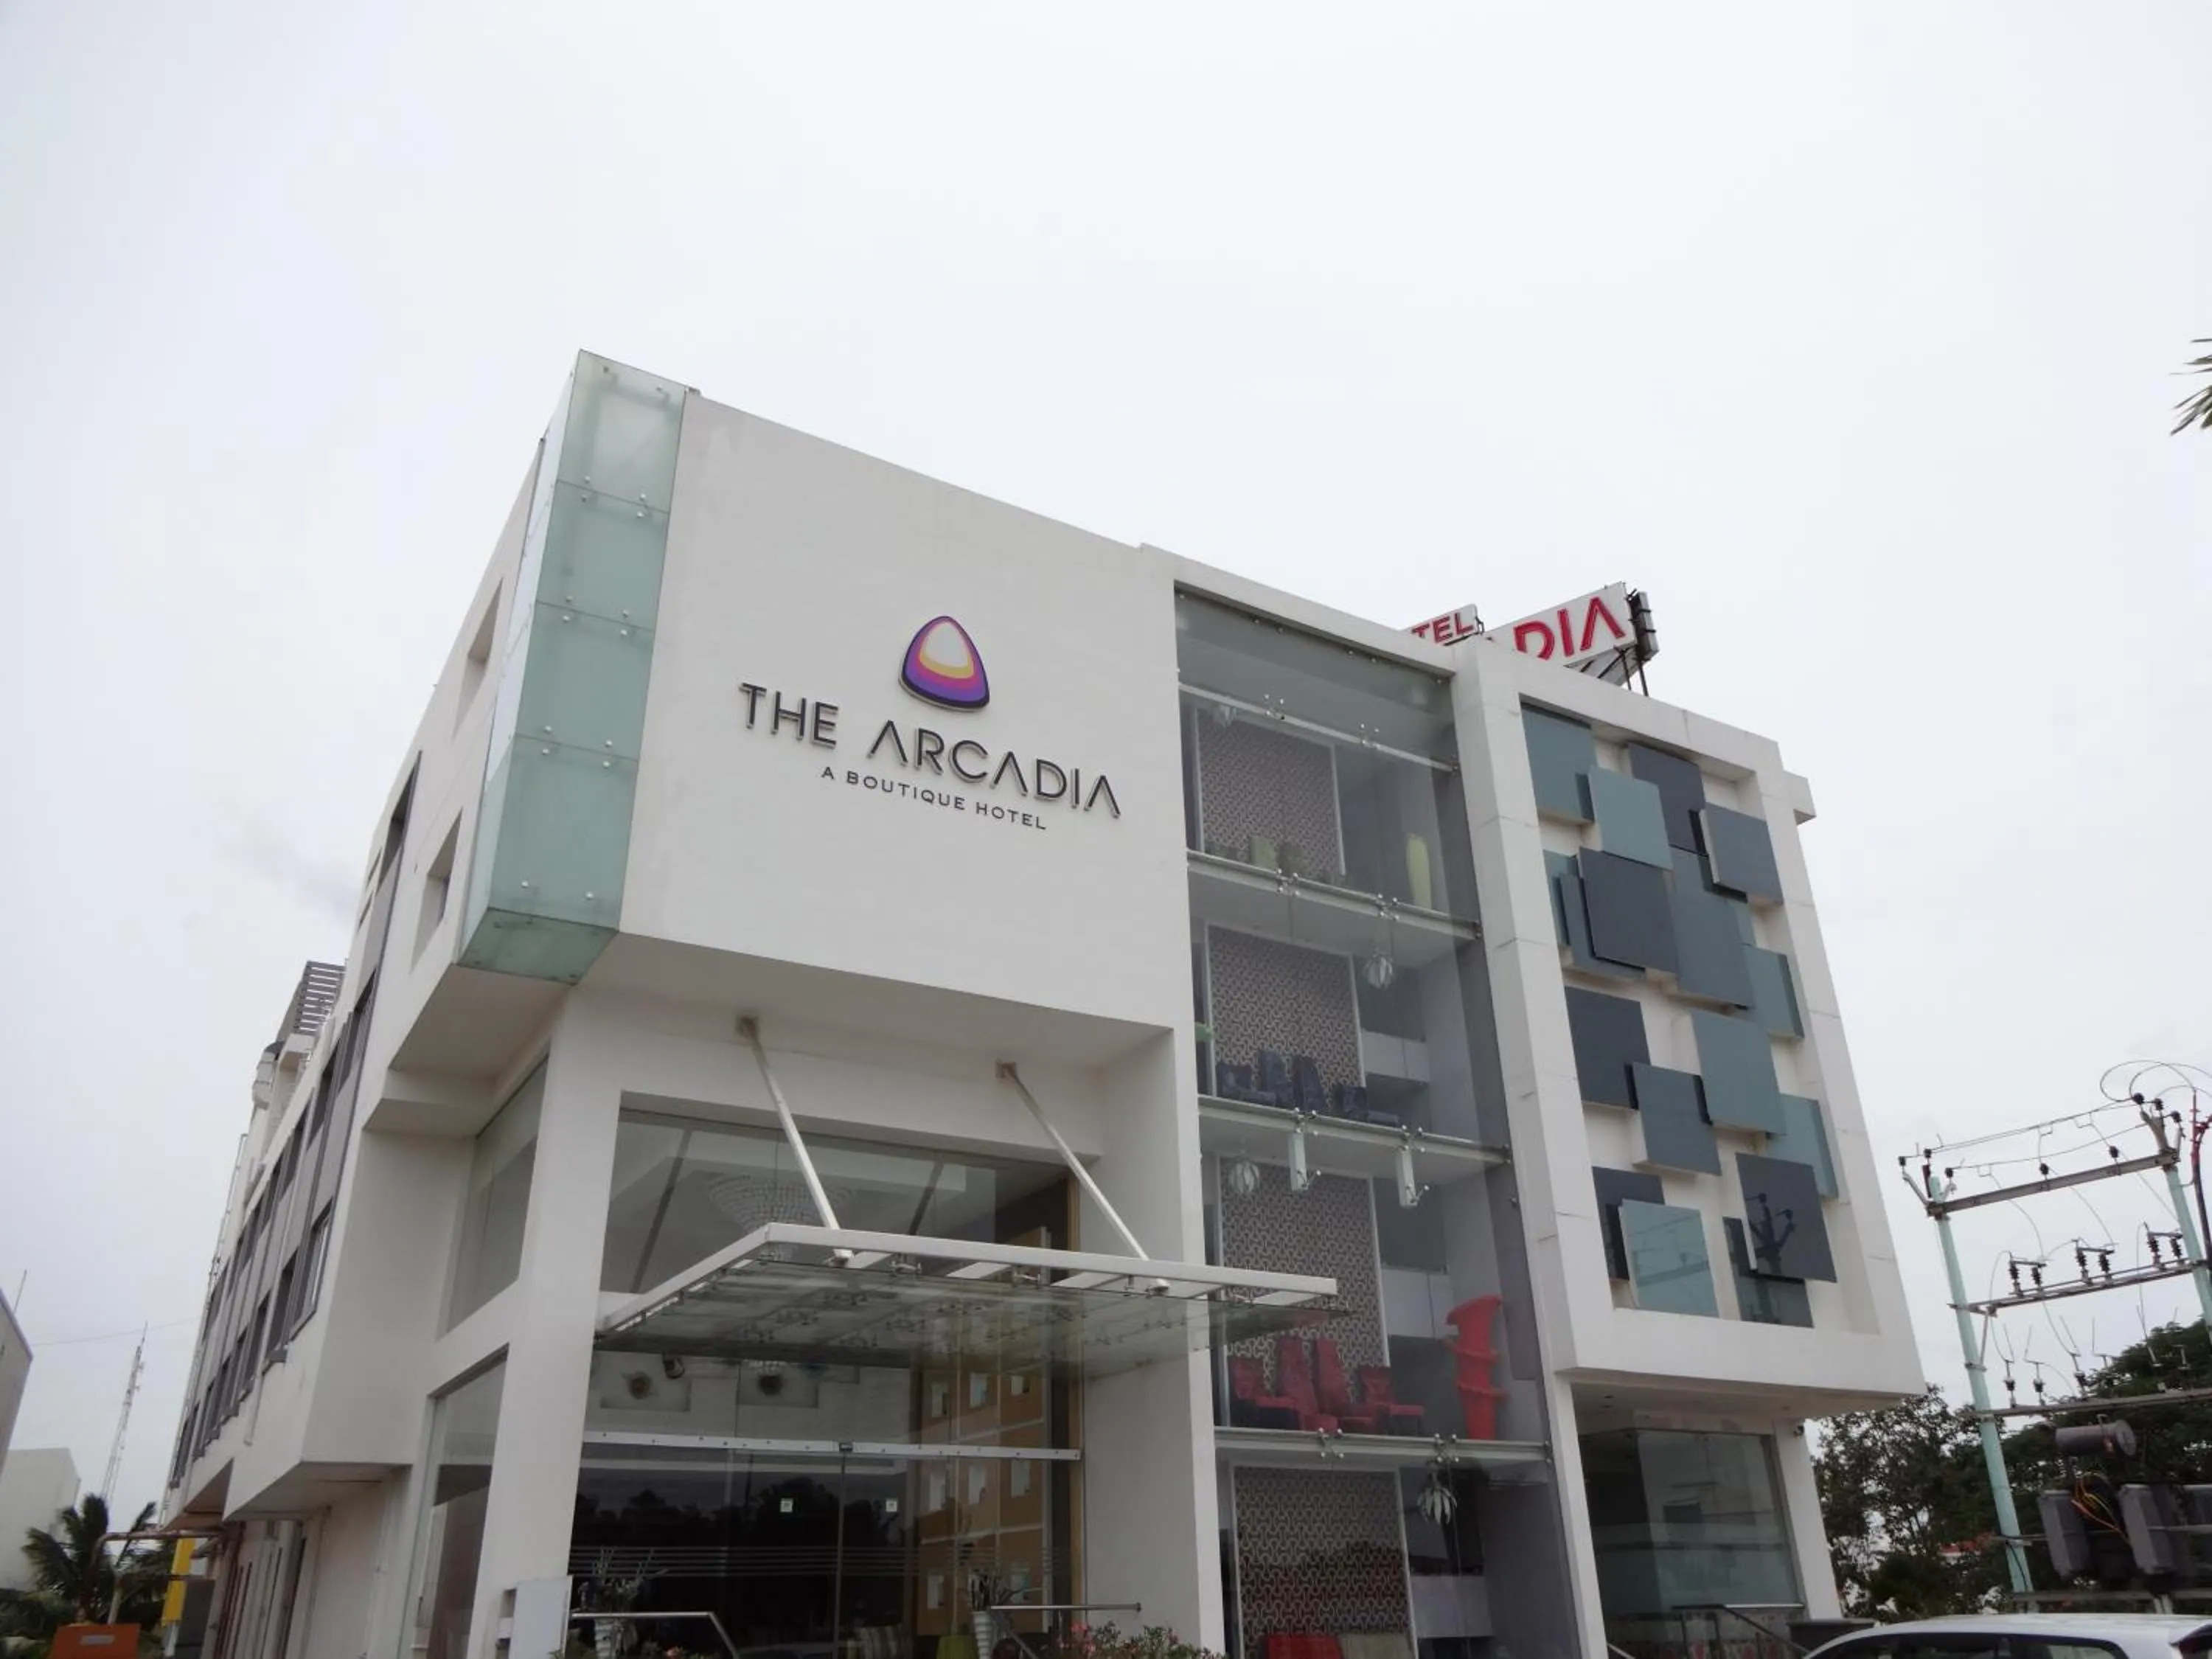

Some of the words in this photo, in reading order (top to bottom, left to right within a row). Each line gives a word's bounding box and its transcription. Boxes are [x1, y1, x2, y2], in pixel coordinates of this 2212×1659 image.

[1484, 597, 1627, 661] DIA
[740, 682, 839, 749] THE
[867, 720, 1121, 818] ARCADIA
[821, 766, 835, 780] A
[845, 771, 967, 811] BOUTIQUE
[975, 801, 1047, 830] HOTEL
